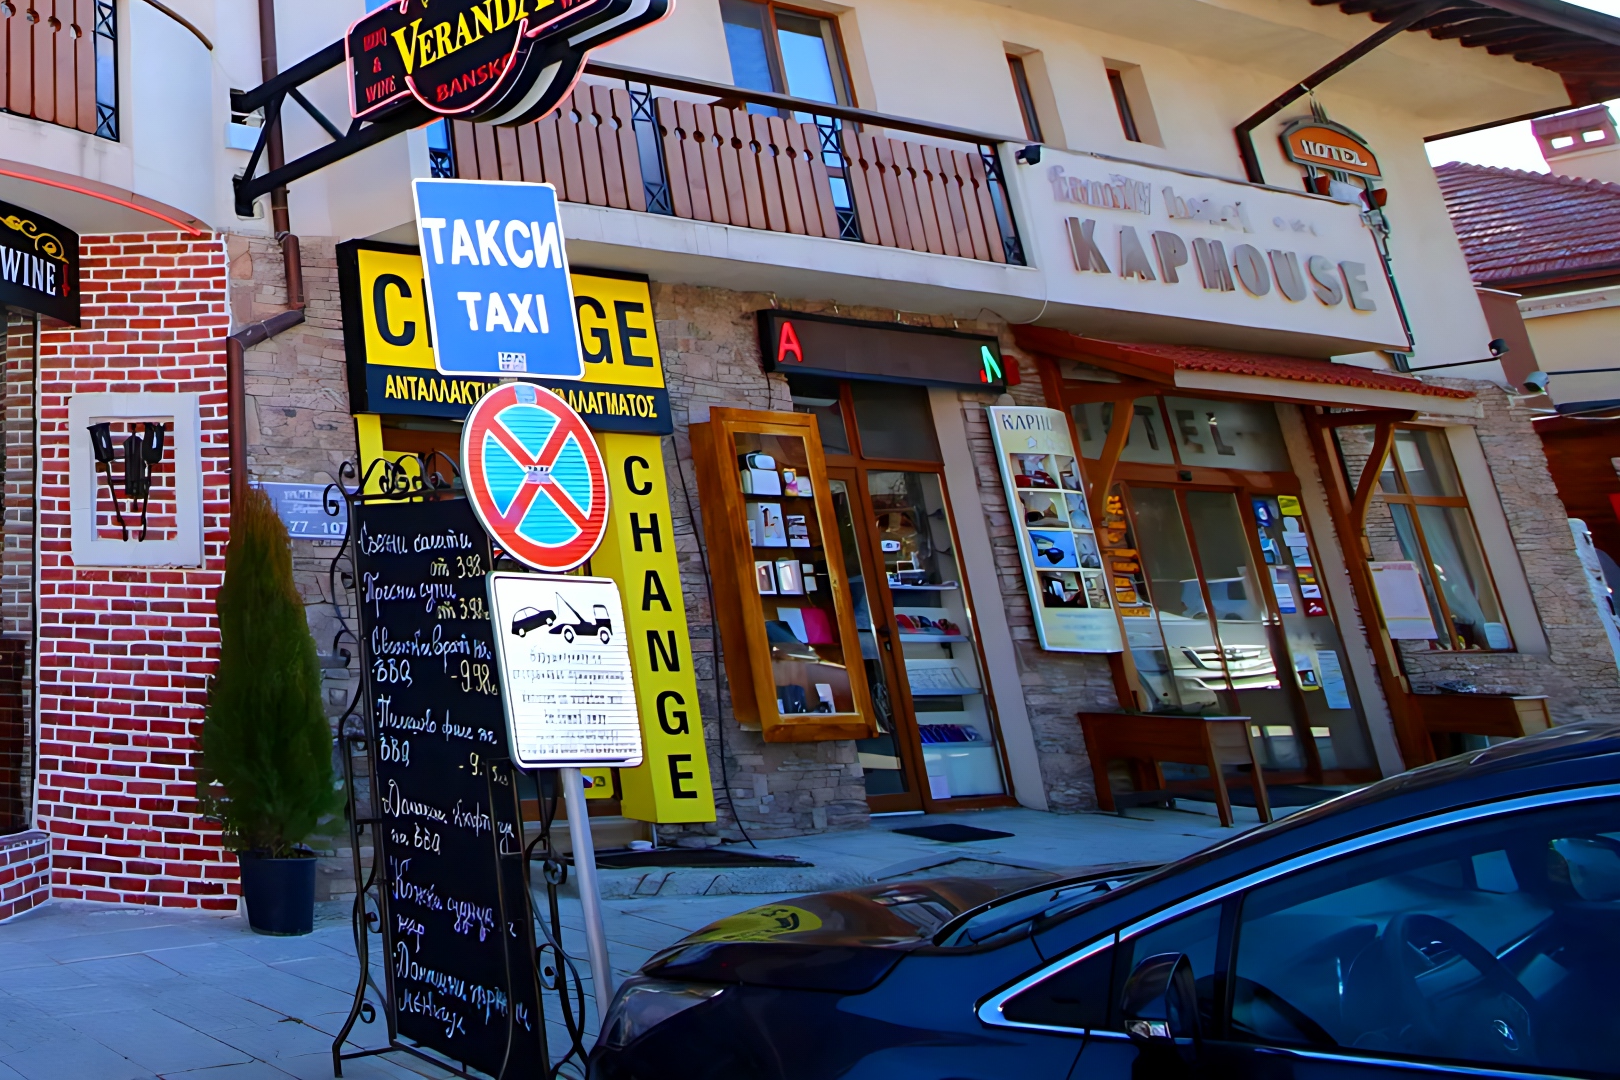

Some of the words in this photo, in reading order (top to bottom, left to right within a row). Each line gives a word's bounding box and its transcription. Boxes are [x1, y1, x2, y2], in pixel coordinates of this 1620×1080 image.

[435, 51, 517, 103] BANSKO
[421, 217, 564, 270] ТАКСИ
[1064, 216, 1378, 312] KAPHOUSE
[0, 244, 57, 297] WINE
[457, 291, 550, 334] TAXI
[623, 454, 699, 800] CHANGE
